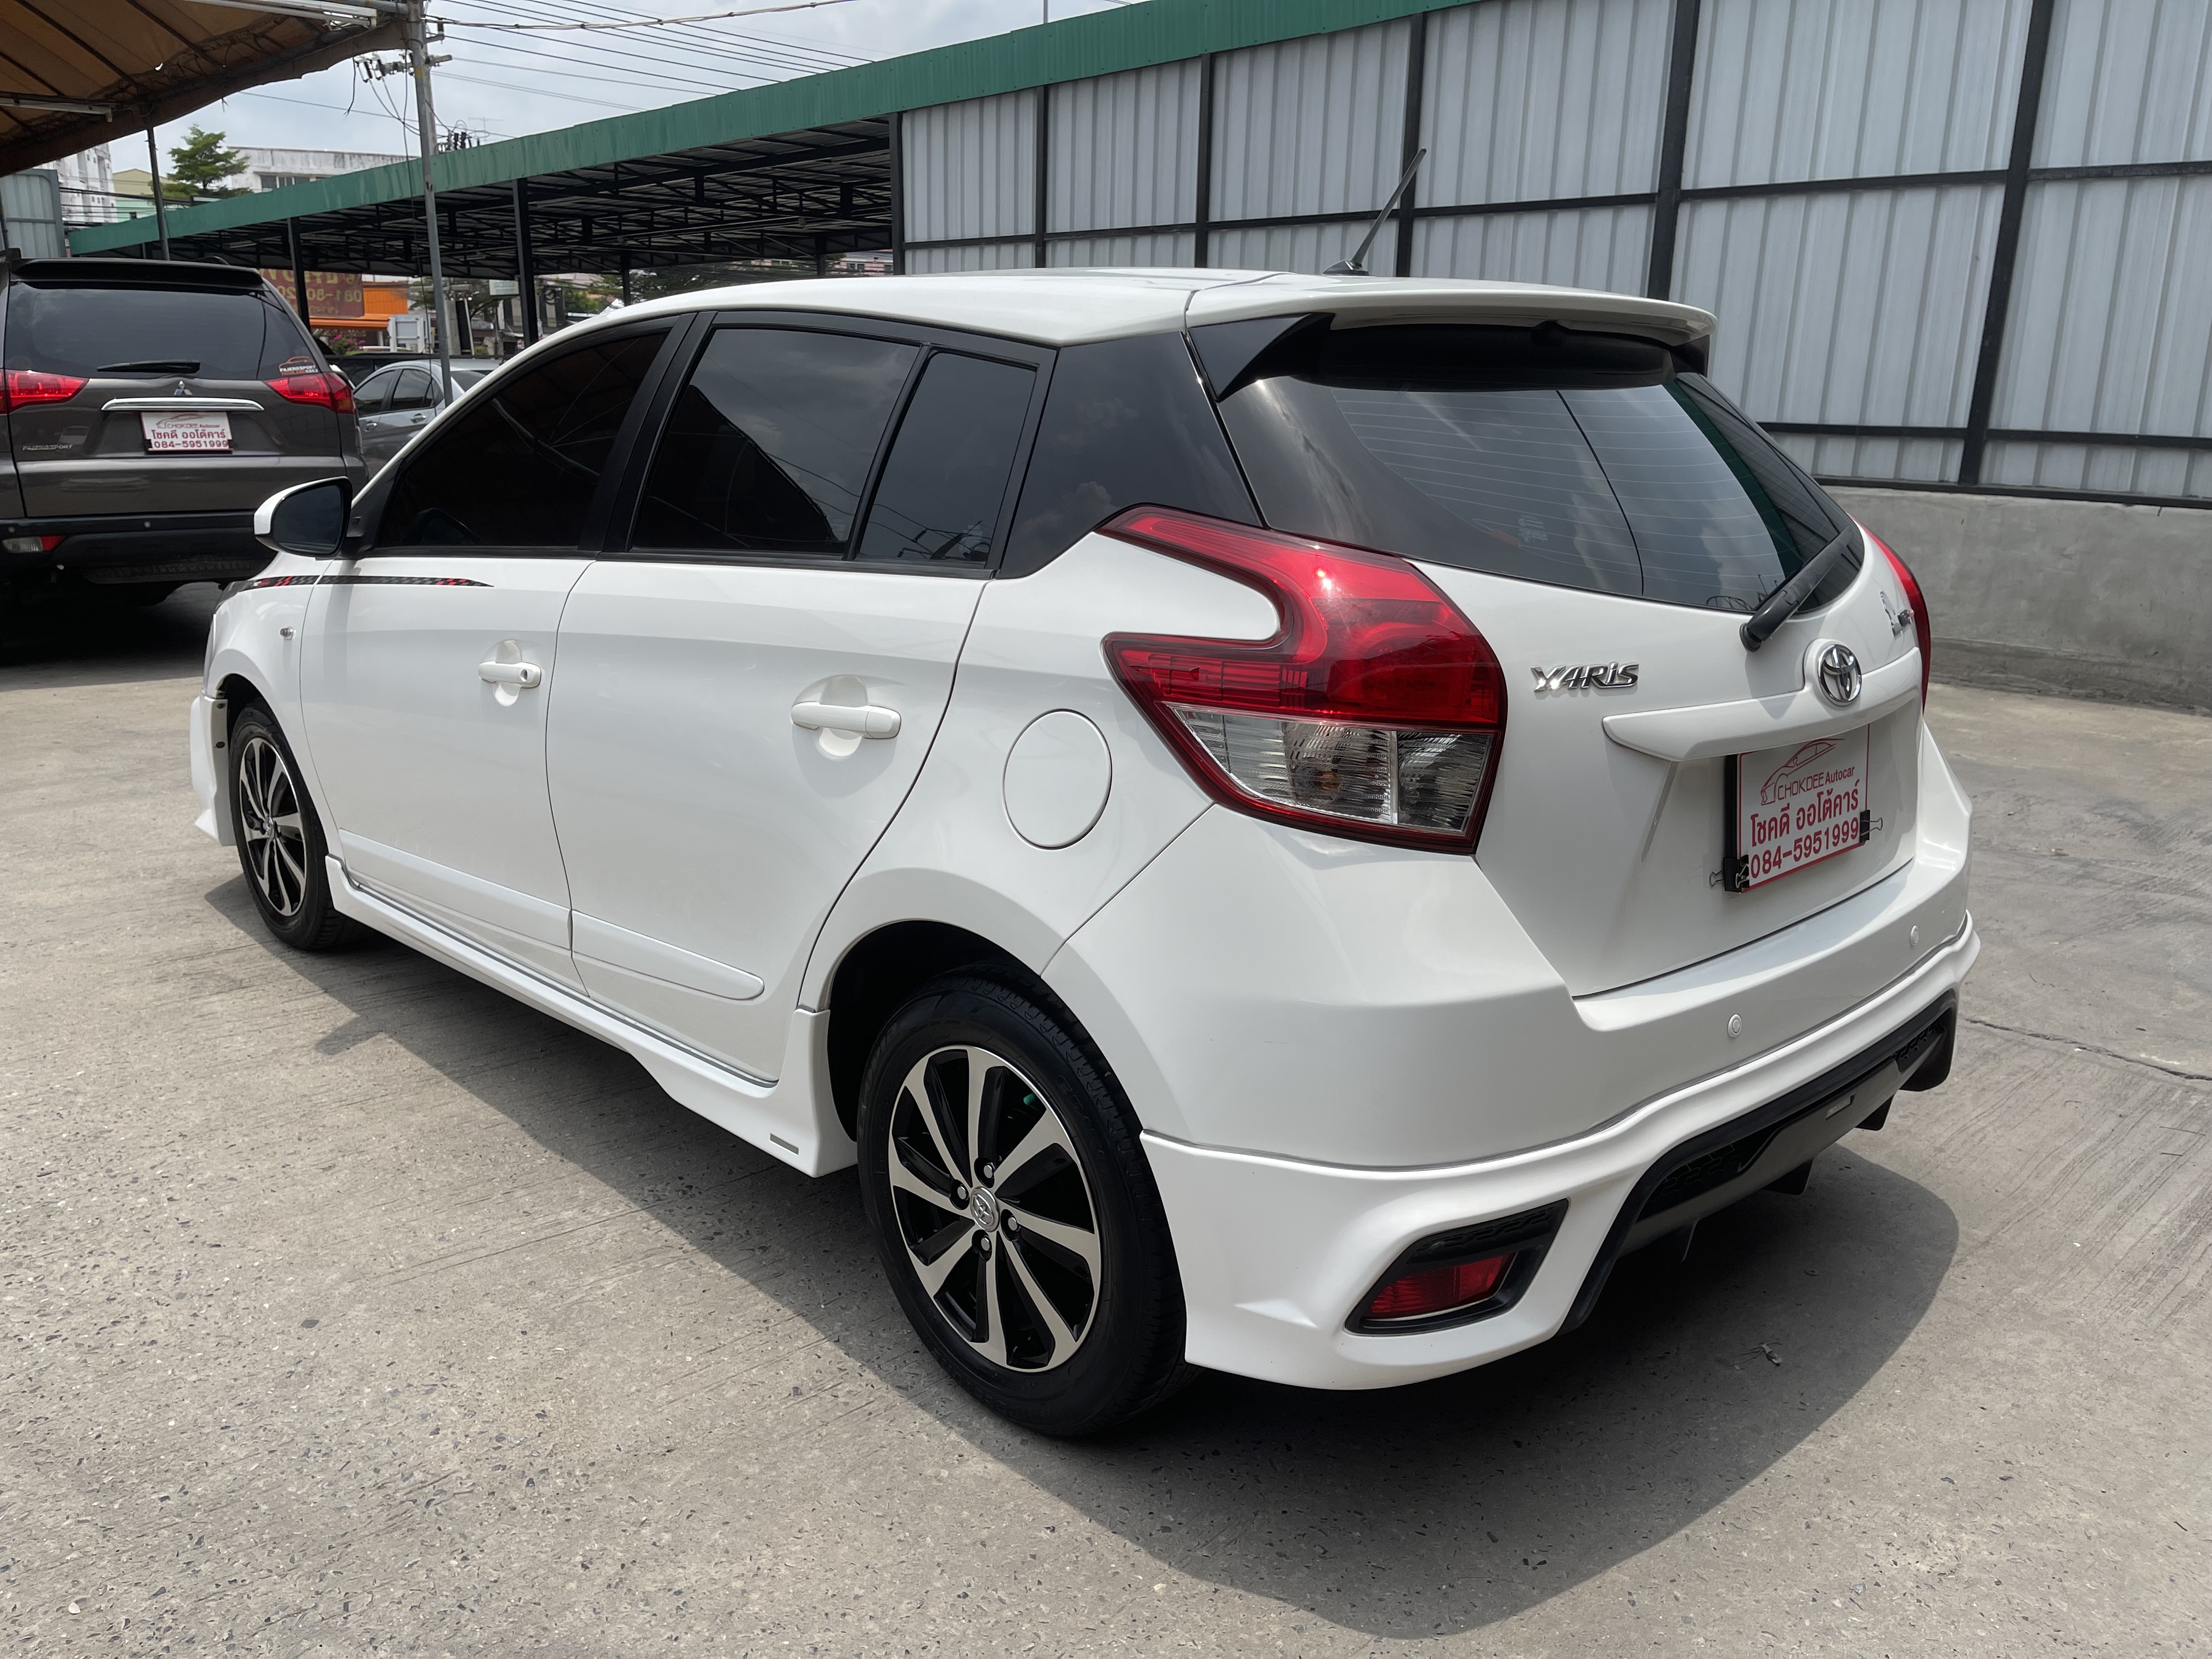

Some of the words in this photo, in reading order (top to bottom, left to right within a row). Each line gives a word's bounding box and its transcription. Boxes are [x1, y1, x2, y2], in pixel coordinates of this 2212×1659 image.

[1750, 803, 1790, 847] โชคดี
[1796, 778, 1860, 831] ออโต้คาร์
[1778, 772, 1824, 800] CHOKDEE
[1825, 766, 1855, 786] Autocar
[1751, 817, 1859, 878] 084-5951999
